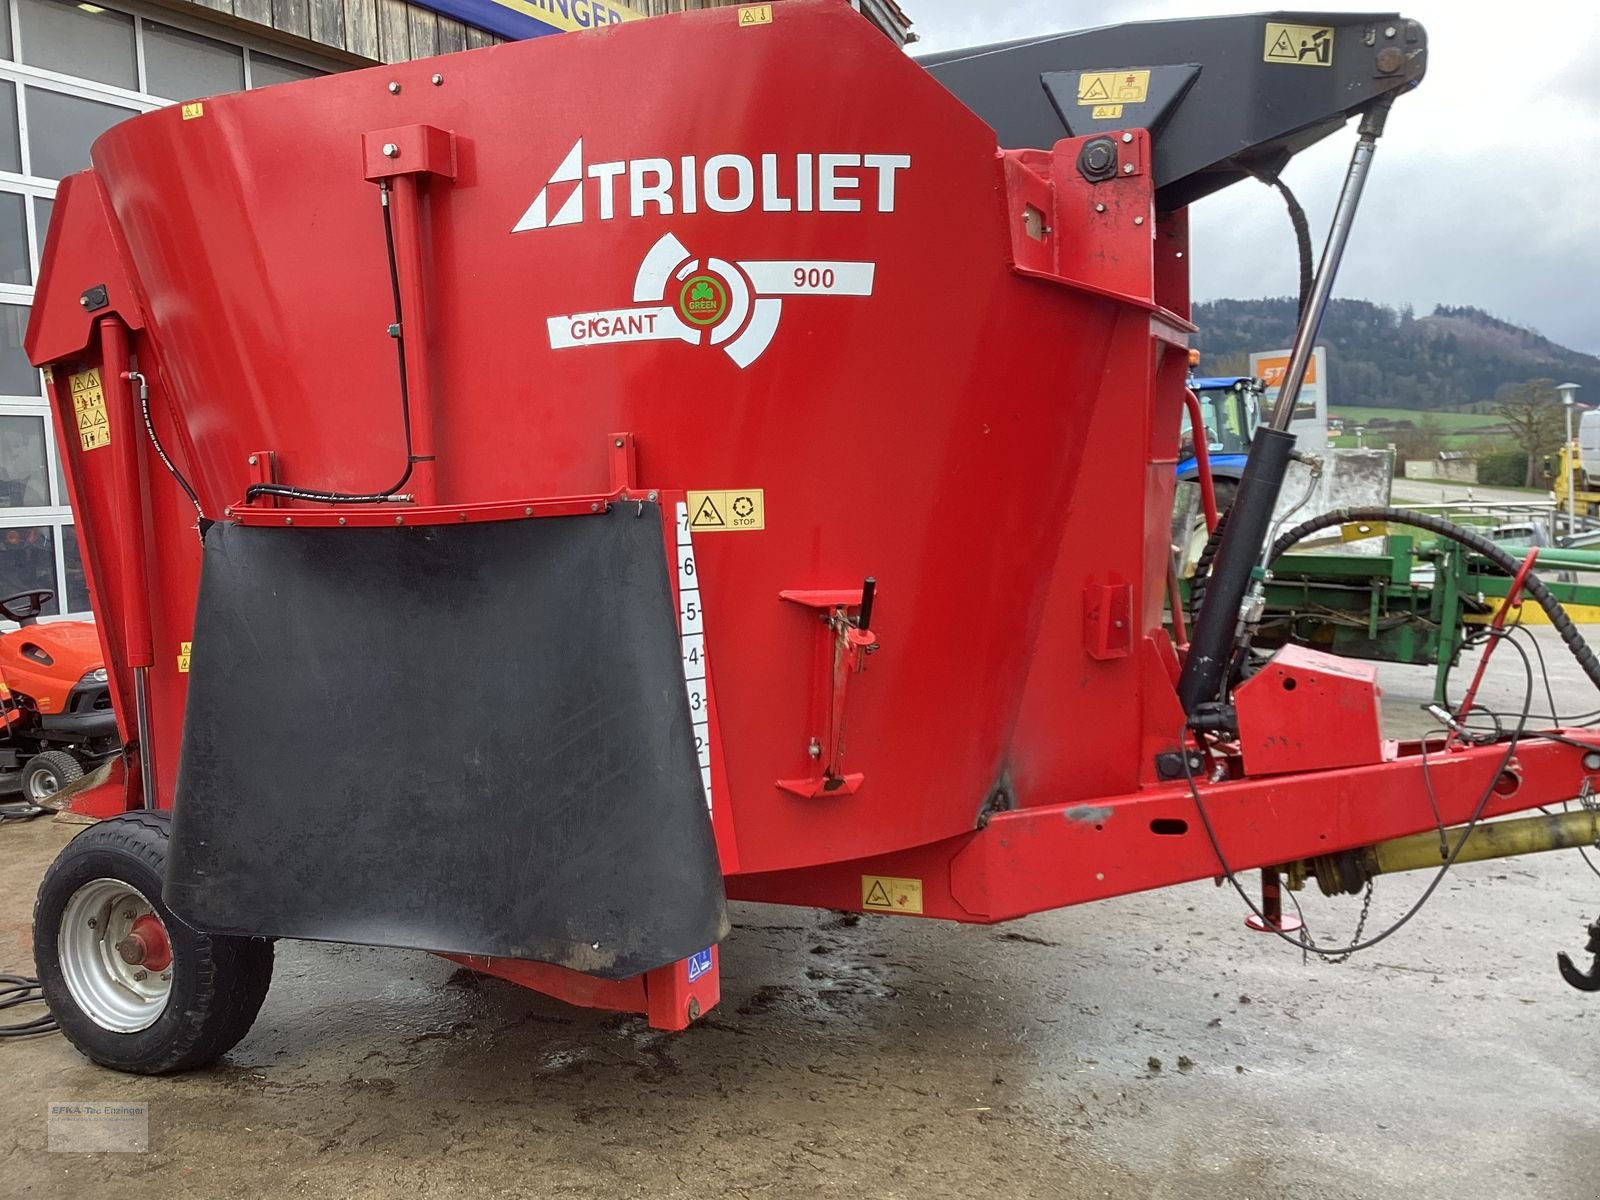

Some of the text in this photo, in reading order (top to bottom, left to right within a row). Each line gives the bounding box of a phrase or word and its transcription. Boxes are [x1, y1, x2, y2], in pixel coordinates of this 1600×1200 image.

[525, 0, 622, 27] NGER
[587, 153, 912, 220] TRIOLIET
[793, 268, 835, 288] 900
[689, 300, 717, 309] GREEN
[570, 314, 658, 340] GIGANT
[733, 518, 756, 526] STOP
[684, 557, 694, 576] 6
[686, 603, 696, 621] 5
[688, 647, 699, 665] 4
[691, 692, 701, 710] 3
